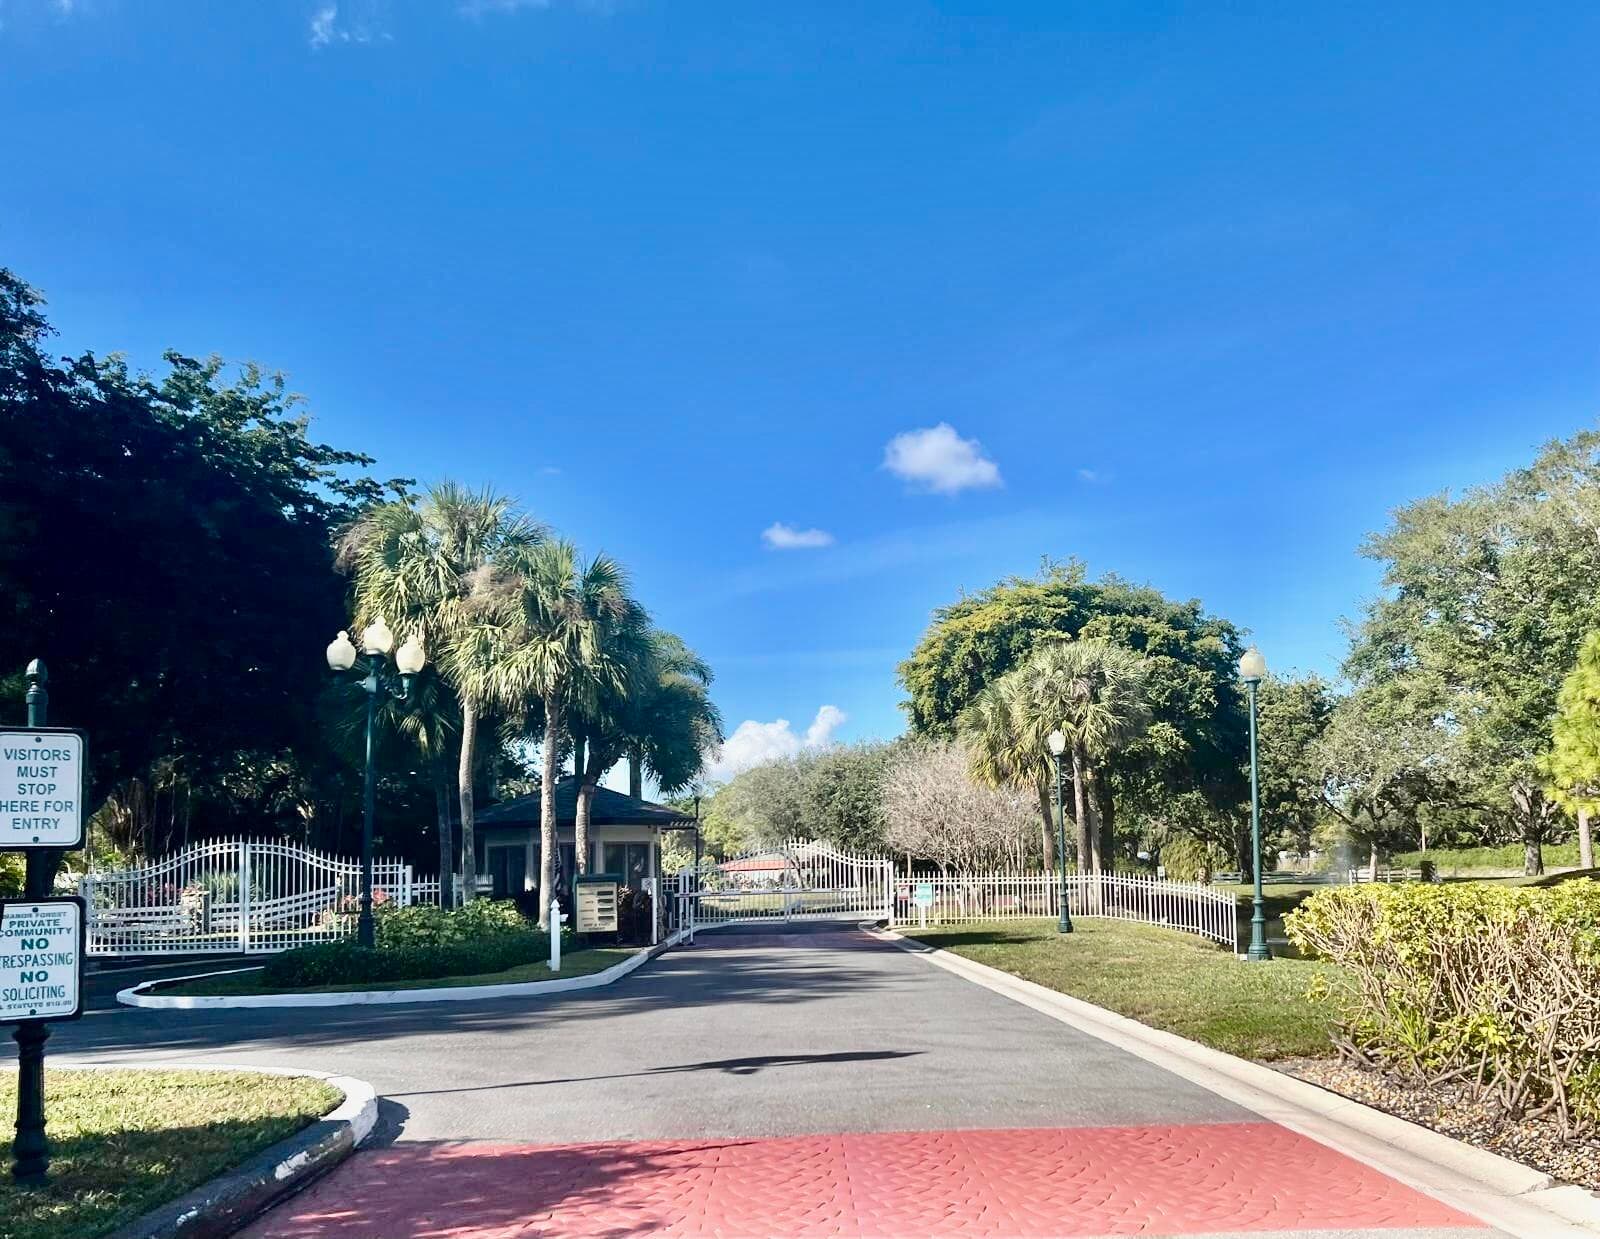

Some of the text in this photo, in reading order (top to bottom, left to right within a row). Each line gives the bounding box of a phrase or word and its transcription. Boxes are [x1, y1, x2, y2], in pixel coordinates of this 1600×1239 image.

[4, 749, 71, 760] VISITORS
[17, 766, 58, 778] MUST
[18, 783, 56, 795] STOP
[0, 800, 73, 812] HERE FOR
[12, 818, 60, 830] ENTRY
[9, 919, 61, 928] PRIVATE
[21, 938, 49, 950] NO
[20, 970, 49, 983] NO
[3, 985, 65, 1001] SOLICITING
